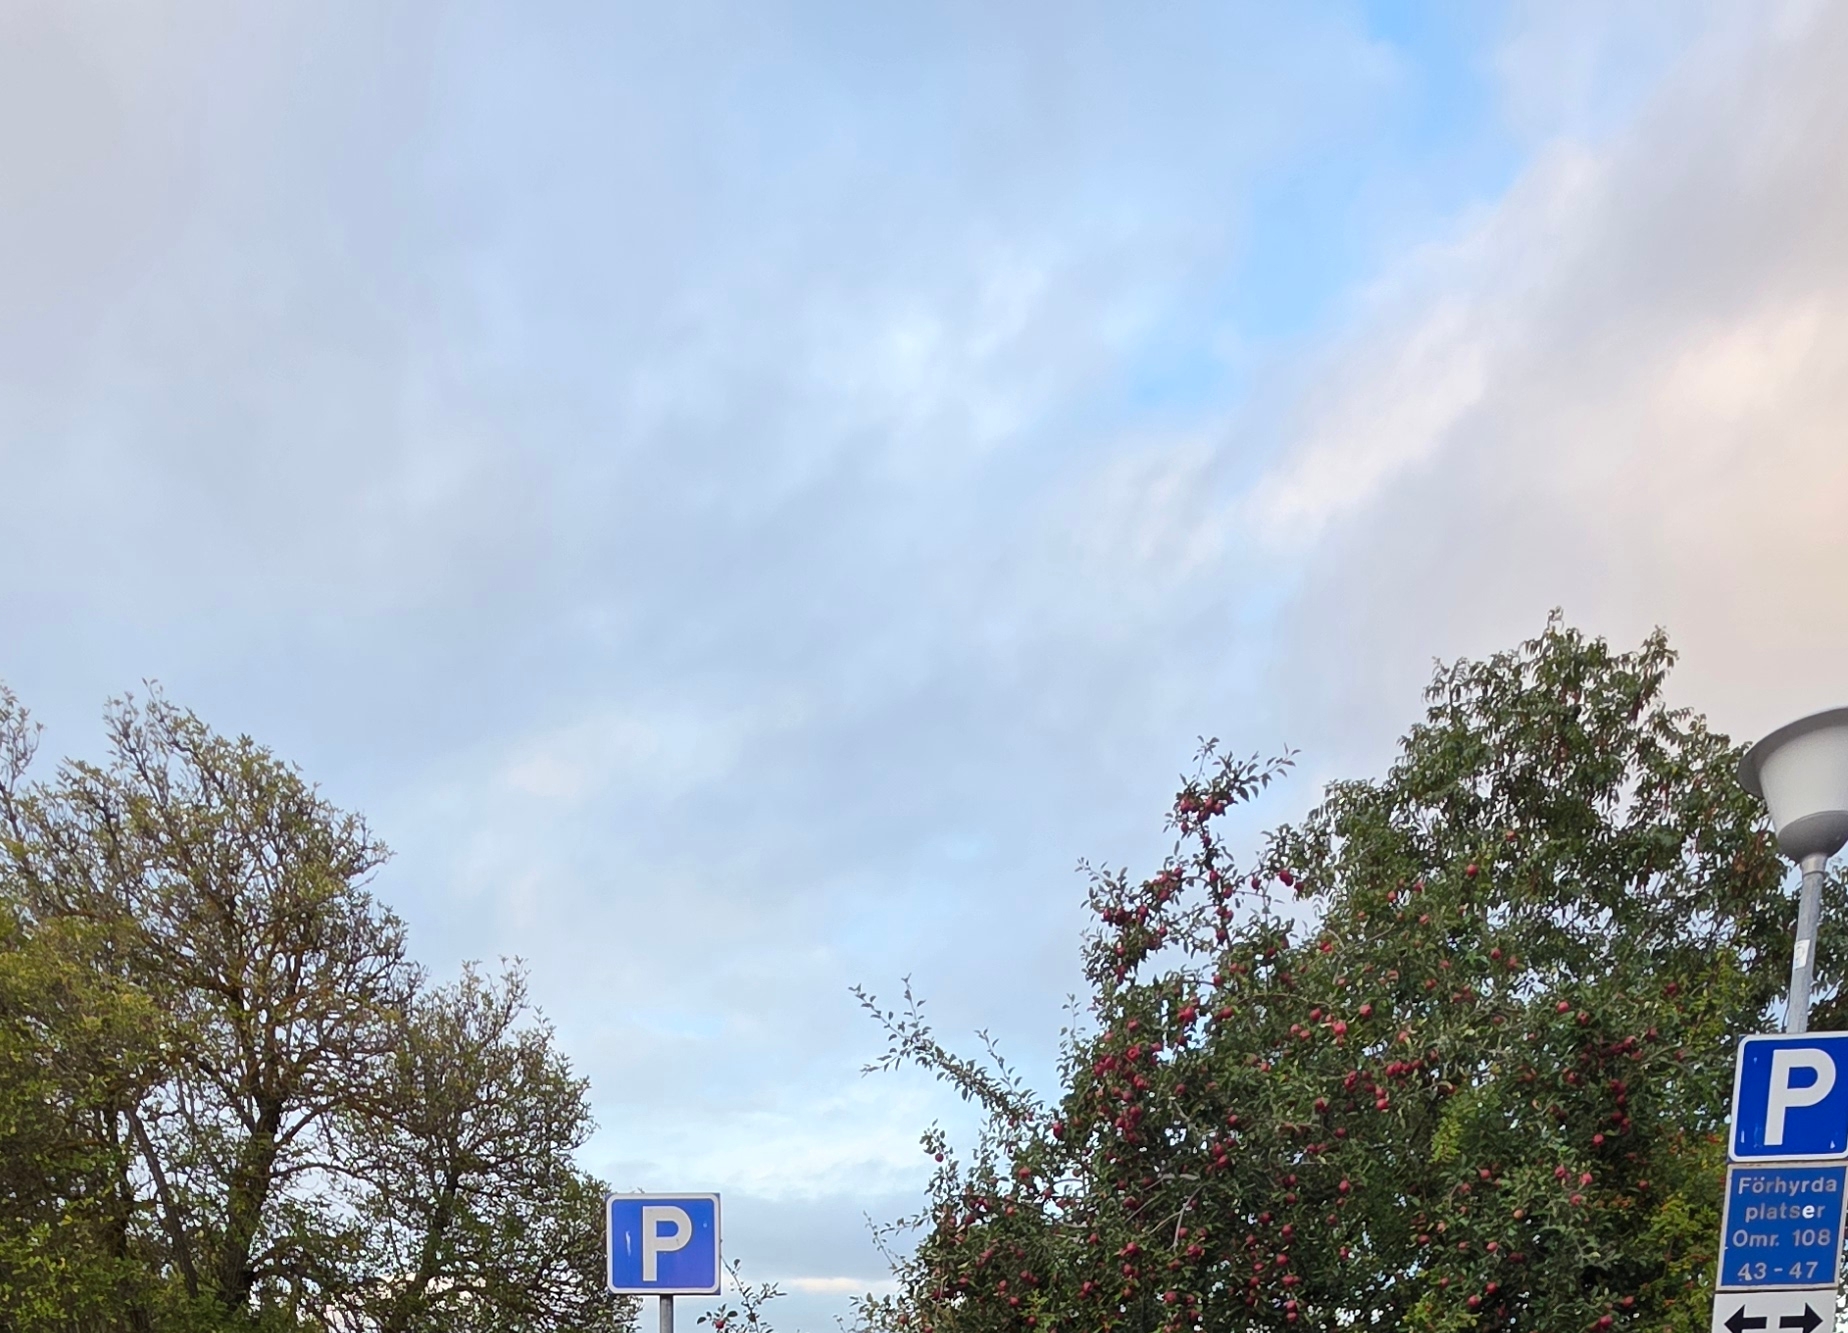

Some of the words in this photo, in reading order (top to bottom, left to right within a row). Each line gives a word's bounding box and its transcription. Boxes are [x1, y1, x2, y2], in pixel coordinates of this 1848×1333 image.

[1763, 1048, 1837, 1146] P
[1738, 1176, 1838, 1197] Förhyrda
[1745, 1202, 1826, 1223] platser
[642, 1205, 692, 1282] P
[1732, 1229, 1780, 1248] Omr.
[1792, 1228, 1831, 1247] 108
